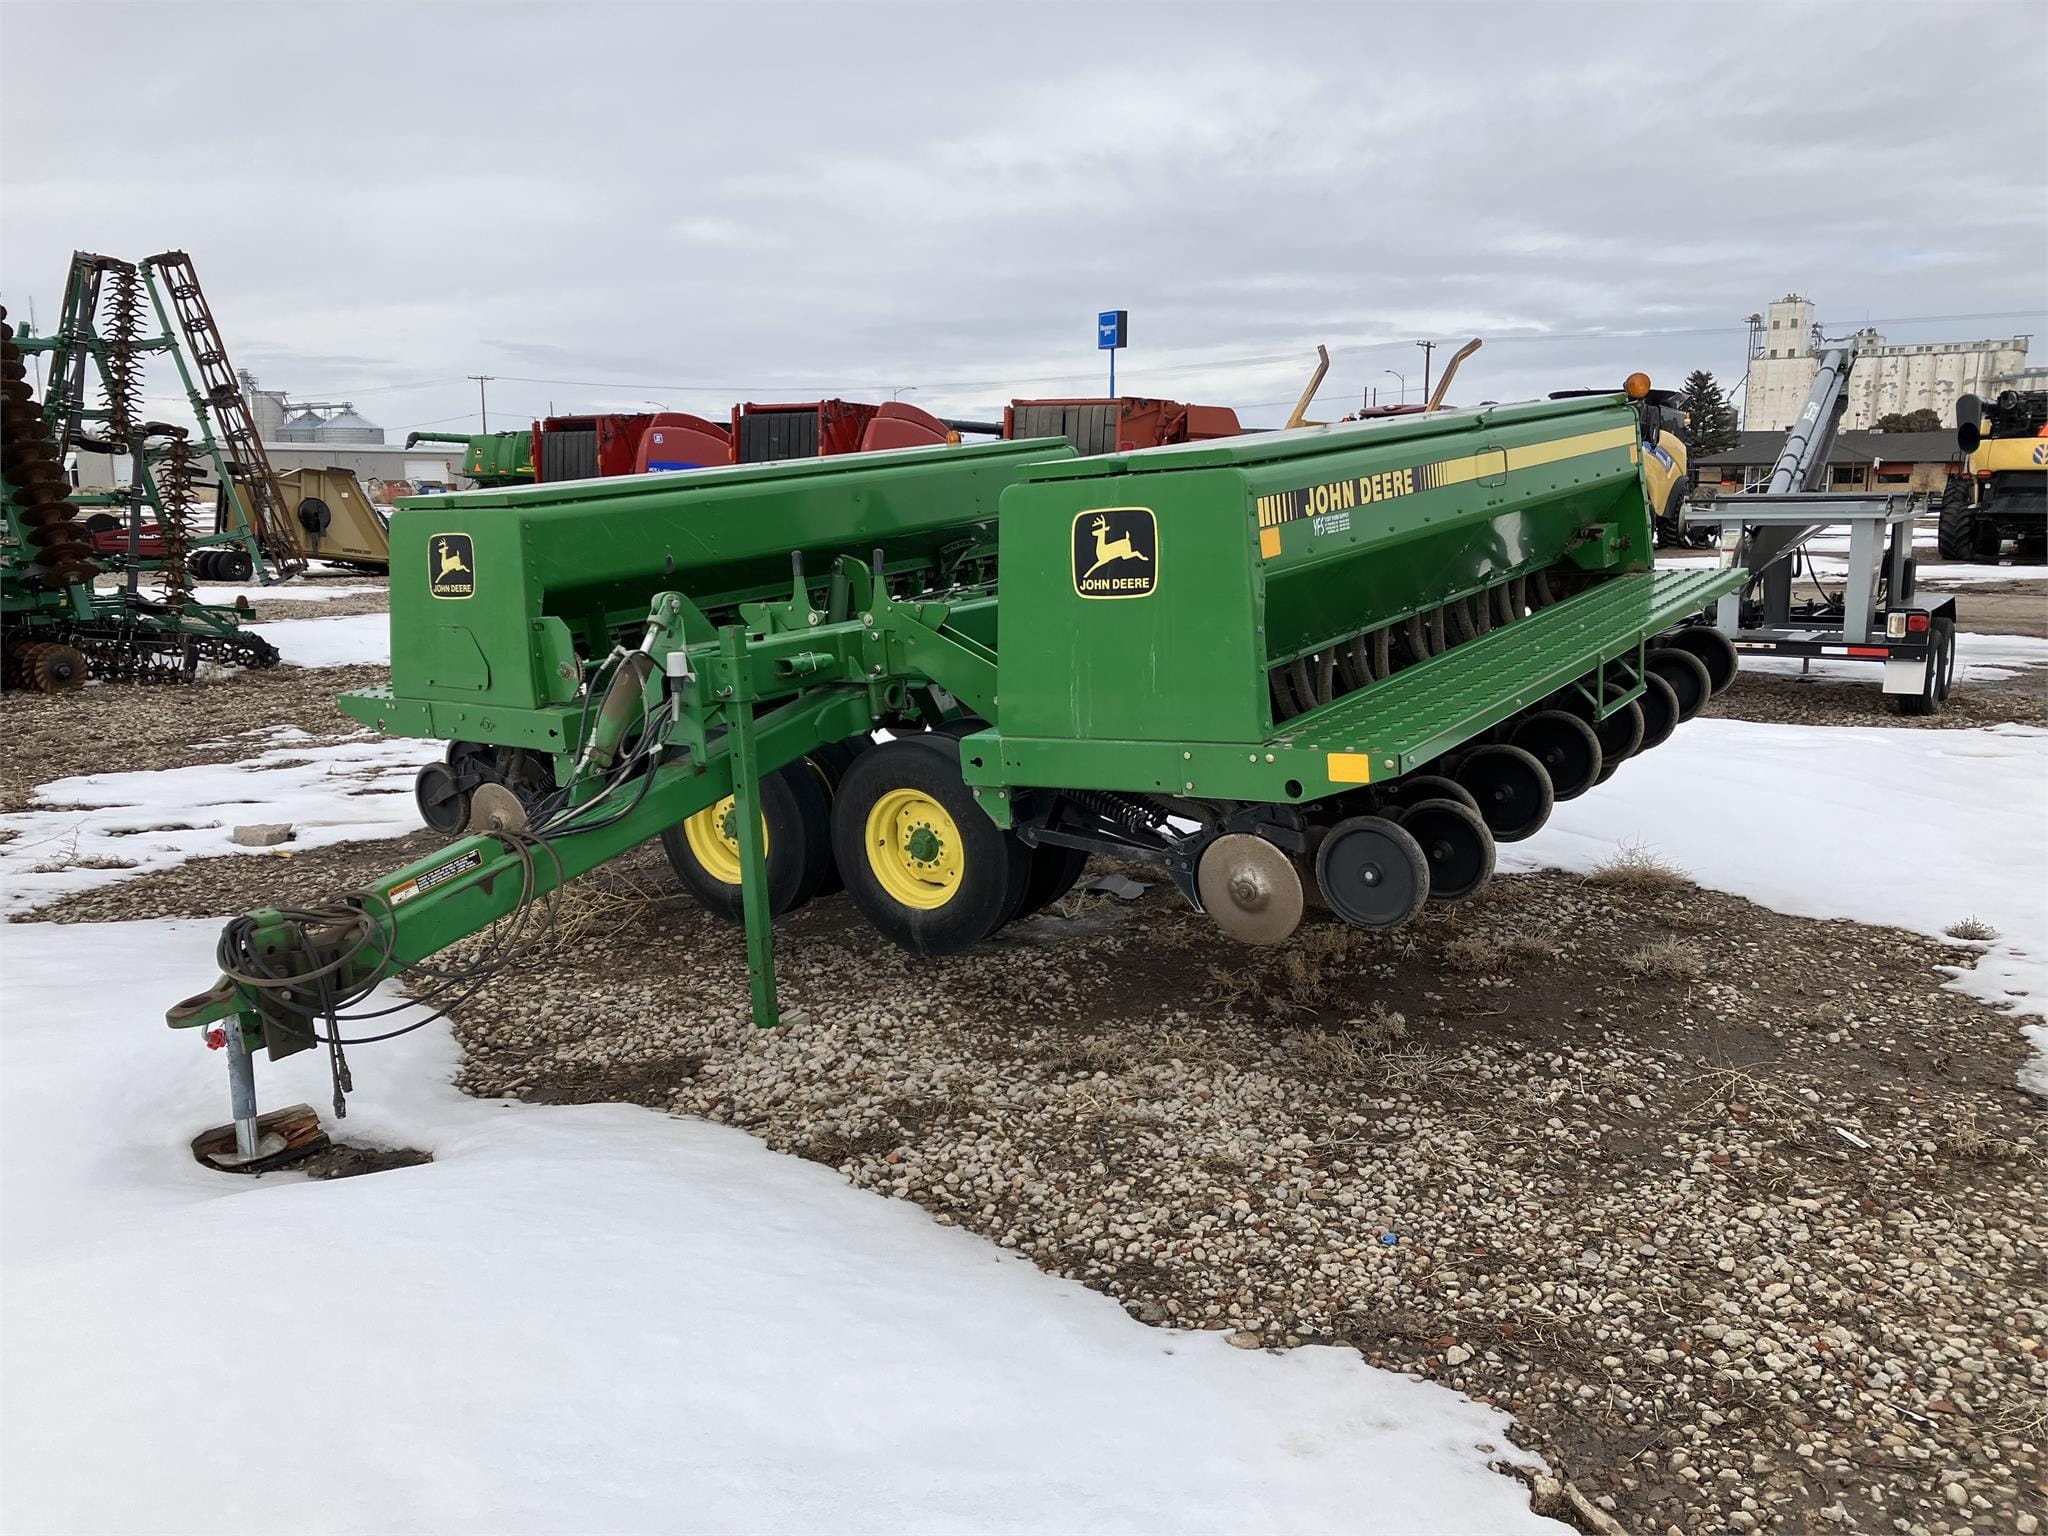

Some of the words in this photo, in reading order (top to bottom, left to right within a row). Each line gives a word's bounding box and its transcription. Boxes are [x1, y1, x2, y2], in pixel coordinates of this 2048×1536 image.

[1305, 480, 1355, 517] JOHN
[1360, 468, 1414, 504] DEERE
[1080, 579, 1110, 590] JOHN
[1112, 577, 1150, 589] DEERE
